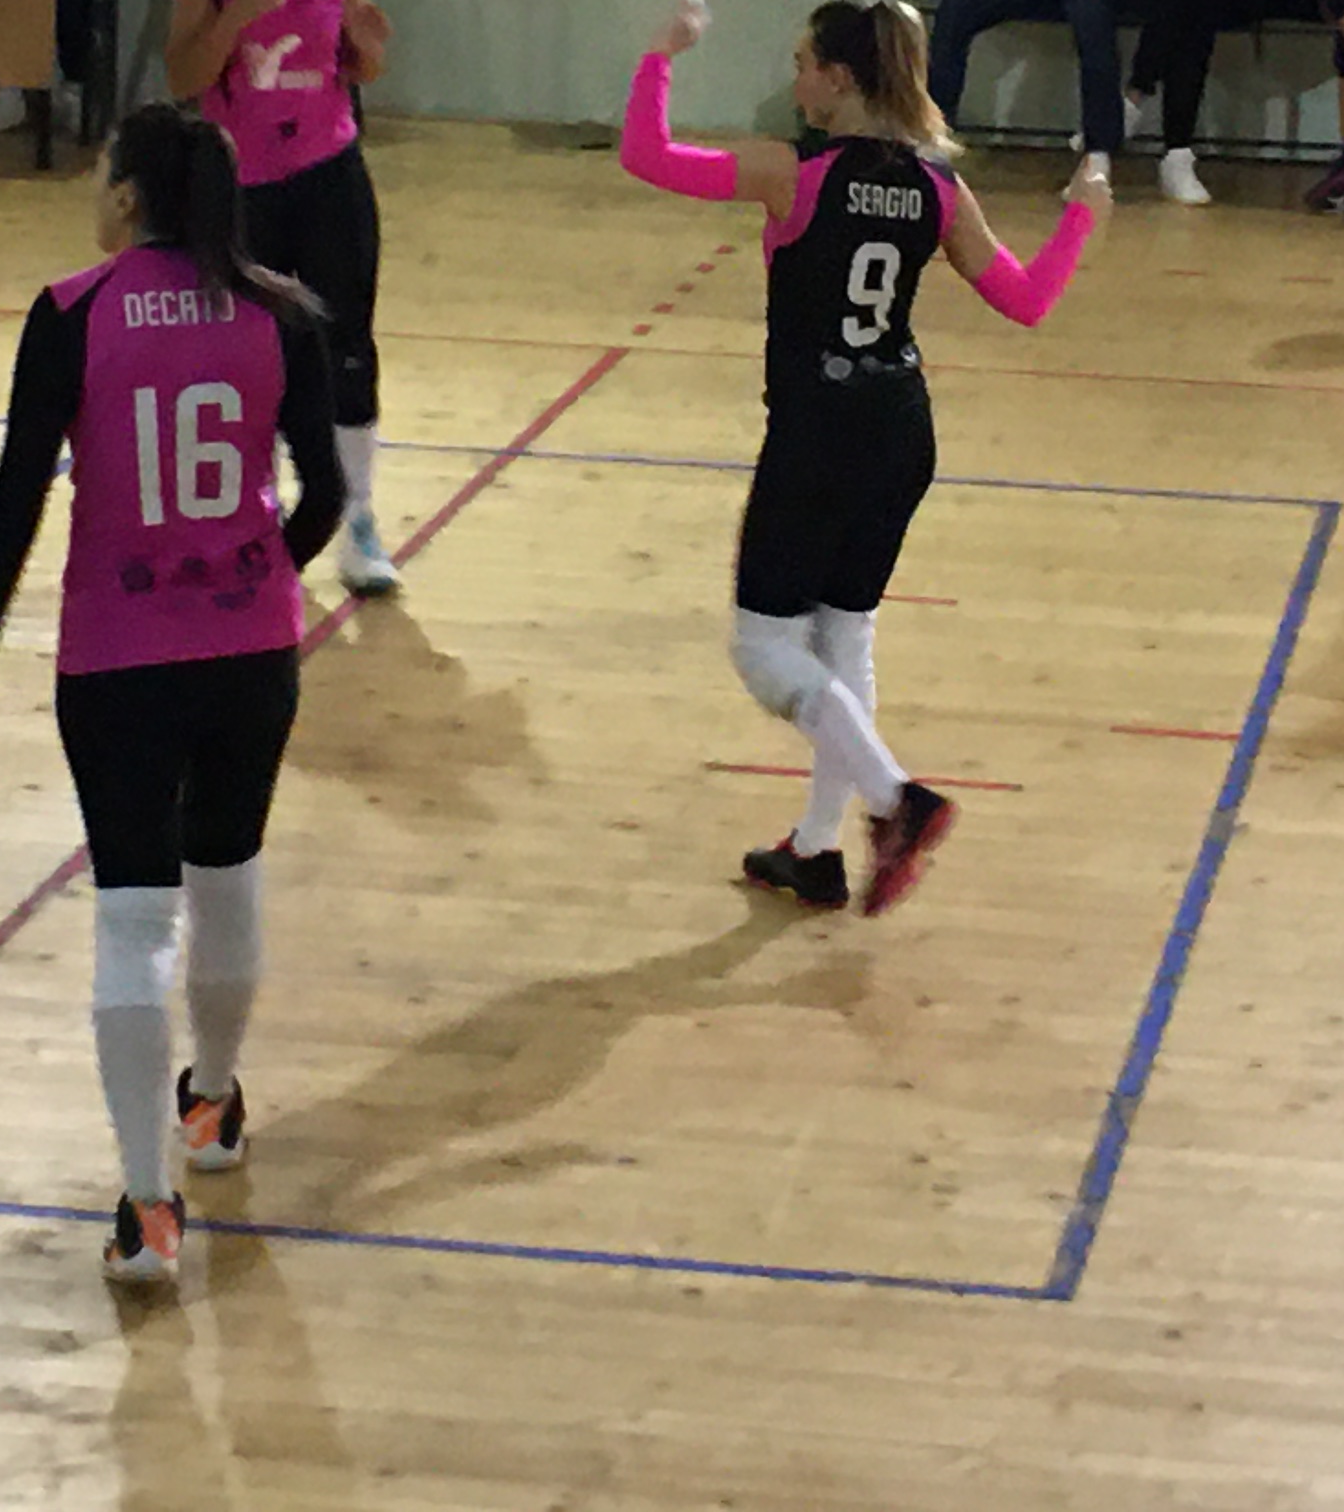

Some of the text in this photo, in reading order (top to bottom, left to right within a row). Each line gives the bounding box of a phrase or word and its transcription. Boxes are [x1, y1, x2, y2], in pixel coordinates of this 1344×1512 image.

[846, 181, 922, 221] SERGIO
[842, 241, 901, 348] 9
[134, 381, 243, 527] 16
